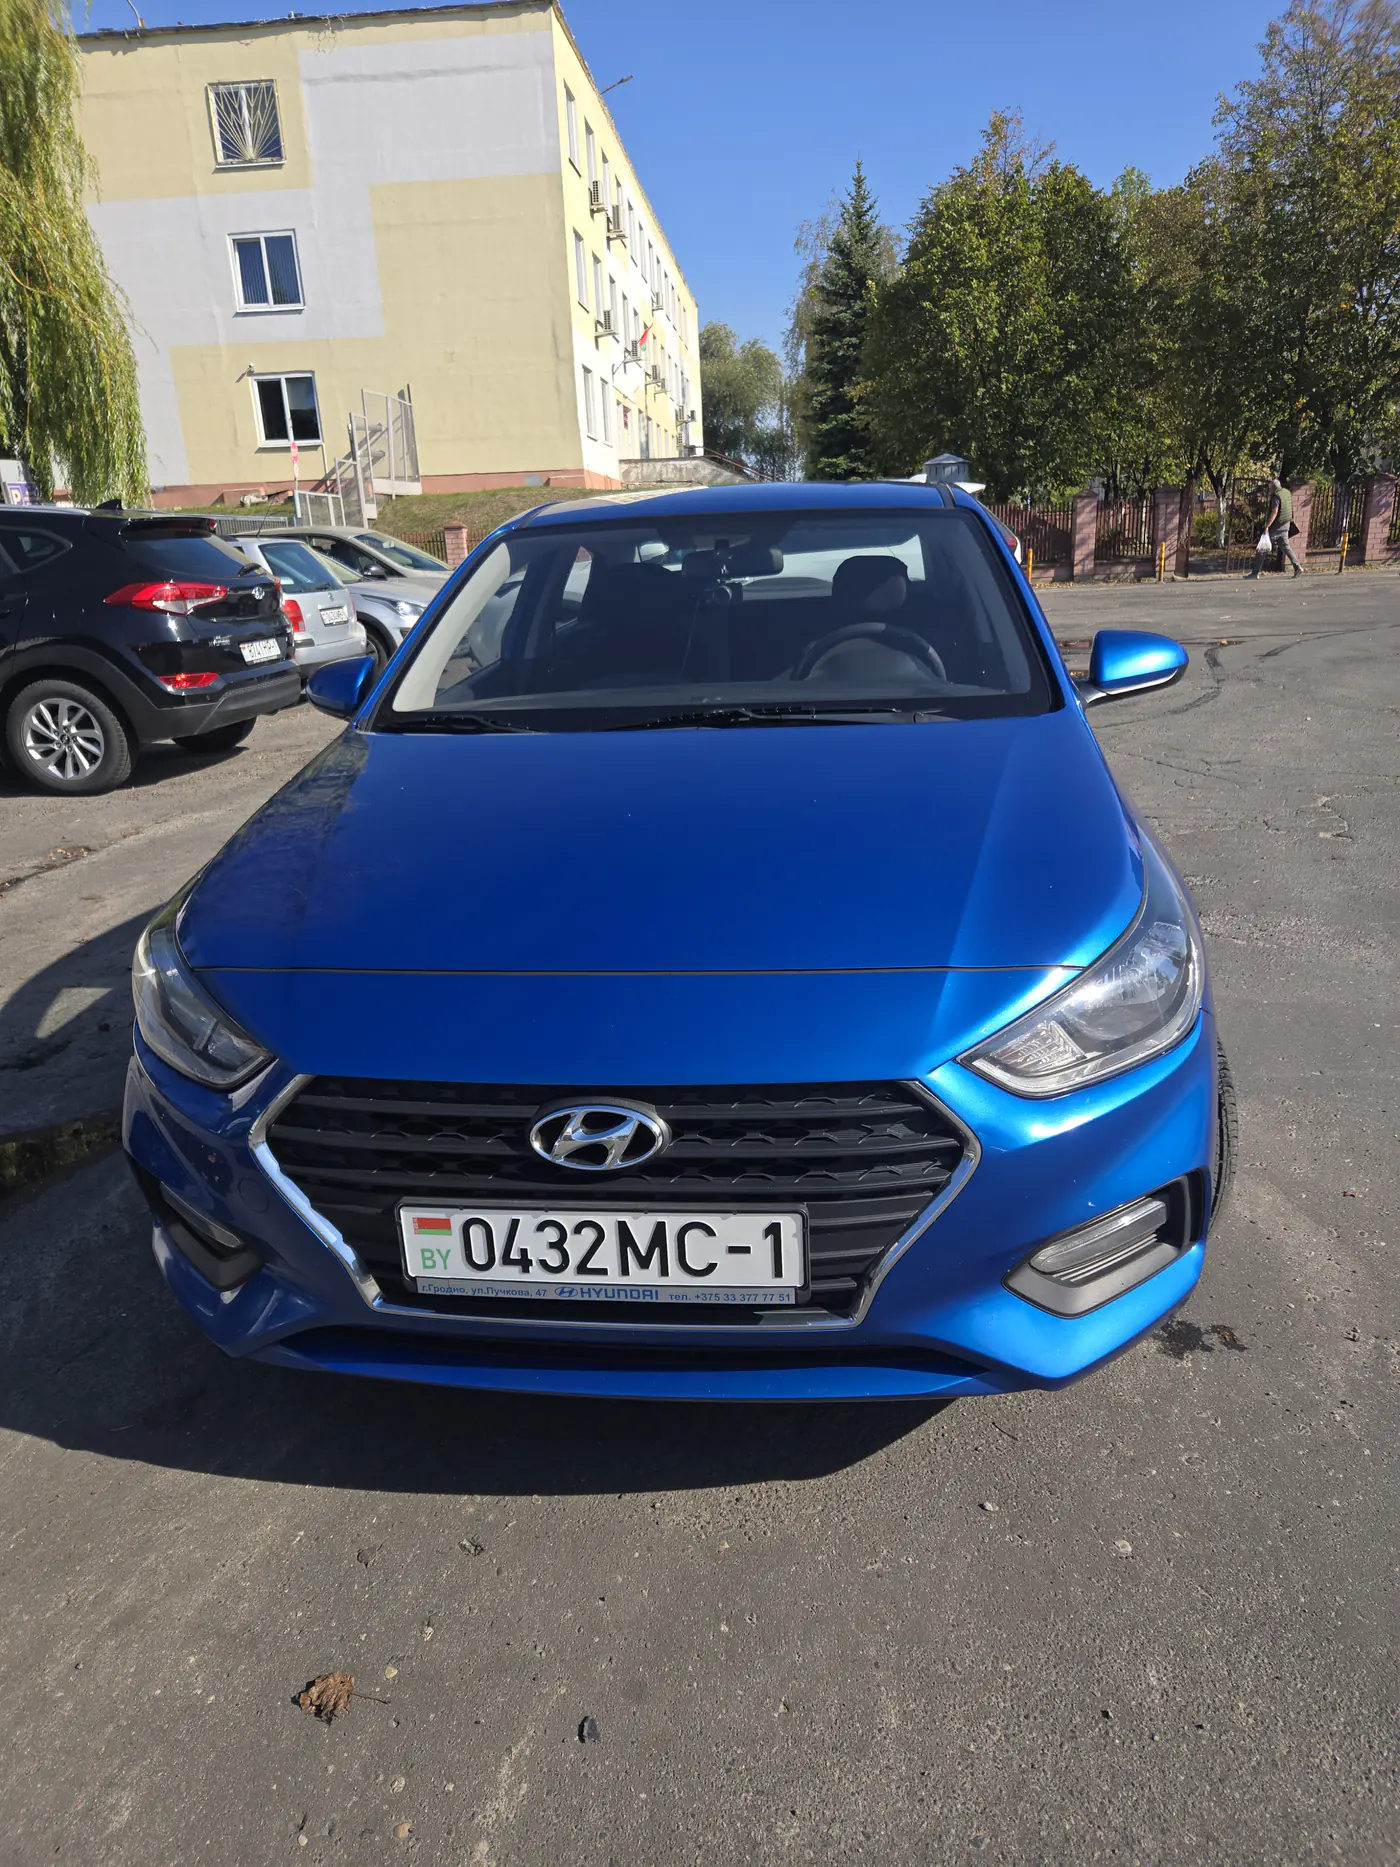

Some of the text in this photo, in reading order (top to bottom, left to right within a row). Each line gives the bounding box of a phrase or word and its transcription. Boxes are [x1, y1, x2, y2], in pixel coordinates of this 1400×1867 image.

[461, 1216, 784, 1279] 0432MC-1
[420, 1248, 451, 1271] BY
[535, 1288, 548, 1297] 47
[580, 1287, 659, 1300] HYUNDAI
[668, 1292, 791, 1302] тел. +375 33 377 77 51
